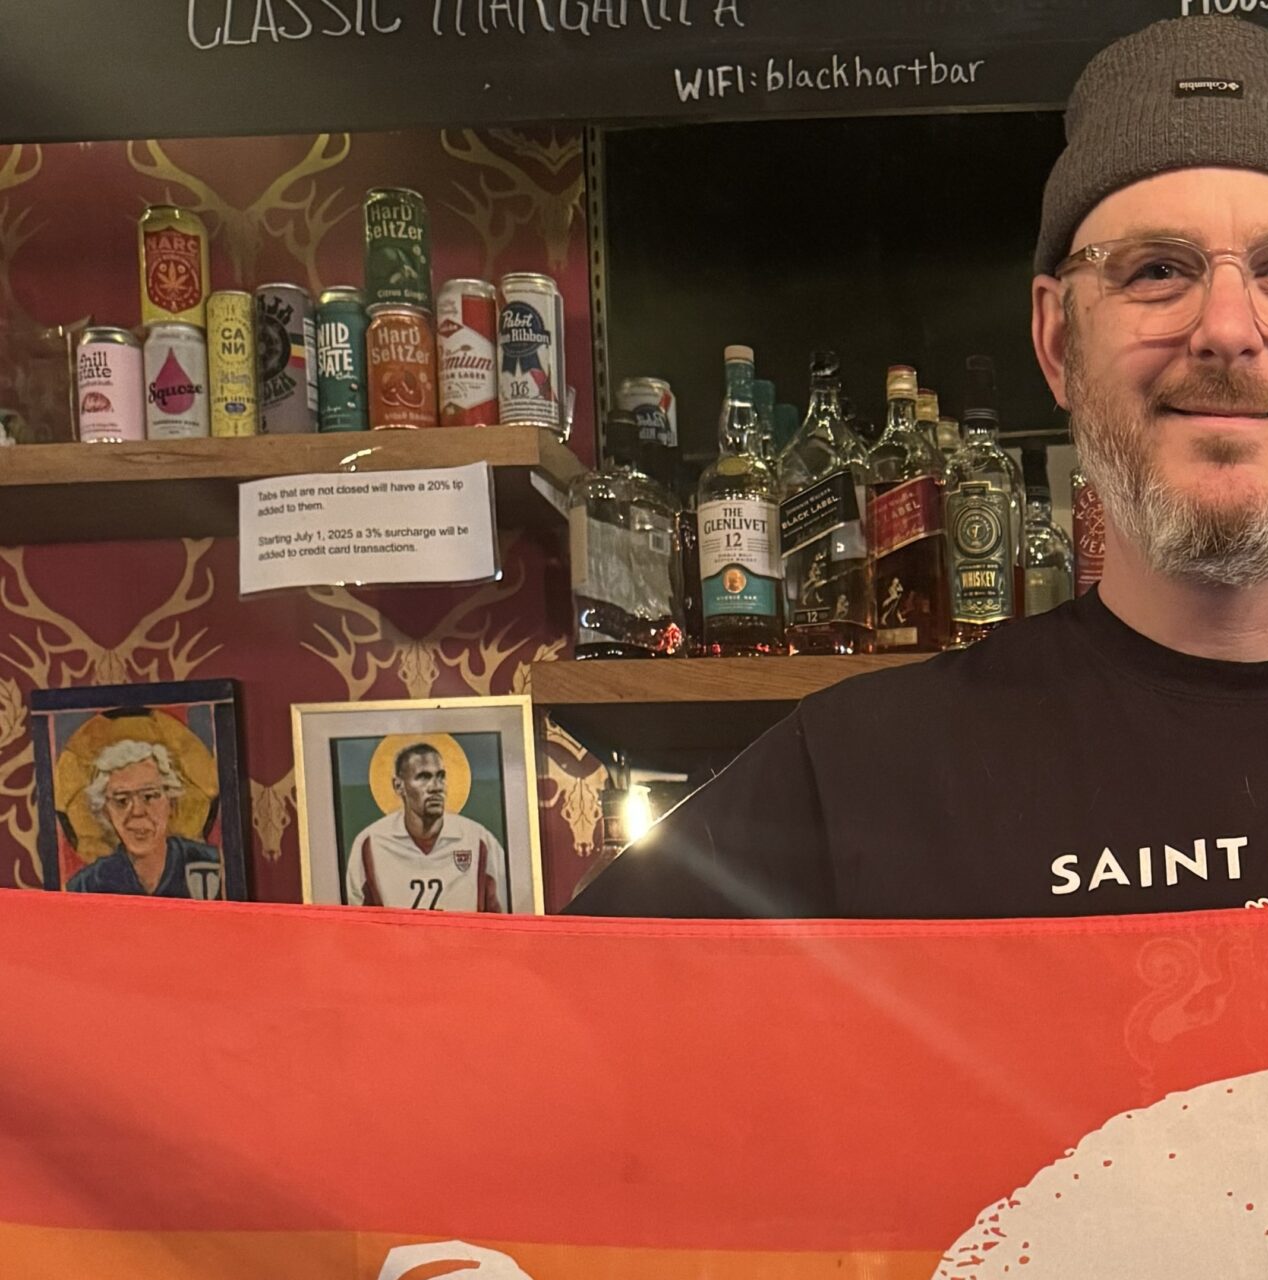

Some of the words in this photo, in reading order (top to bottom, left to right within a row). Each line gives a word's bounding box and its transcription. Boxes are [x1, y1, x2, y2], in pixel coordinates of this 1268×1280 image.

[766, 51, 985, 92] blackhartbar
[257, 491, 278, 501] Tabs
[280, 488, 298, 499] that
[299, 488, 315, 497] are
[318, 486, 334, 495] not
[336, 484, 370, 495] closed
[371, 482, 388, 493] will
[390, 482, 416, 492] have
[427, 480, 450, 491] 20%
[453, 480, 464, 491] tip
[257, 504, 284, 517] added
[286, 504, 296, 513] to
[298, 501, 324, 512] them.
[723, 507, 744, 518] THE
[781, 511, 810, 530] BLACK
[810, 495, 839, 514] LABEL
[258, 533, 292, 546] Starting
[294, 530, 313, 543] July
[328, 529, 354, 540] 2025
[365, 528, 382, 538] 3%
[385, 526, 437, 539] surcharge
[439, 526, 455, 536] will
[457, 525, 469, 536] be
[703, 519, 768, 535] GLENLIVET
[725, 532, 743, 547] 12
[258, 548, 286, 561] added
[287, 548, 297, 558] to
[299, 545, 327, 557] credit
[328, 544, 351, 555] card
[353, 543, 418, 554] transactions.
[961, 570, 996, 588] WHISKEY
[806, 611, 818, 623] 12
[1051, 836, 1249, 895] SAINT
[410, 878, 444, 911] 22
